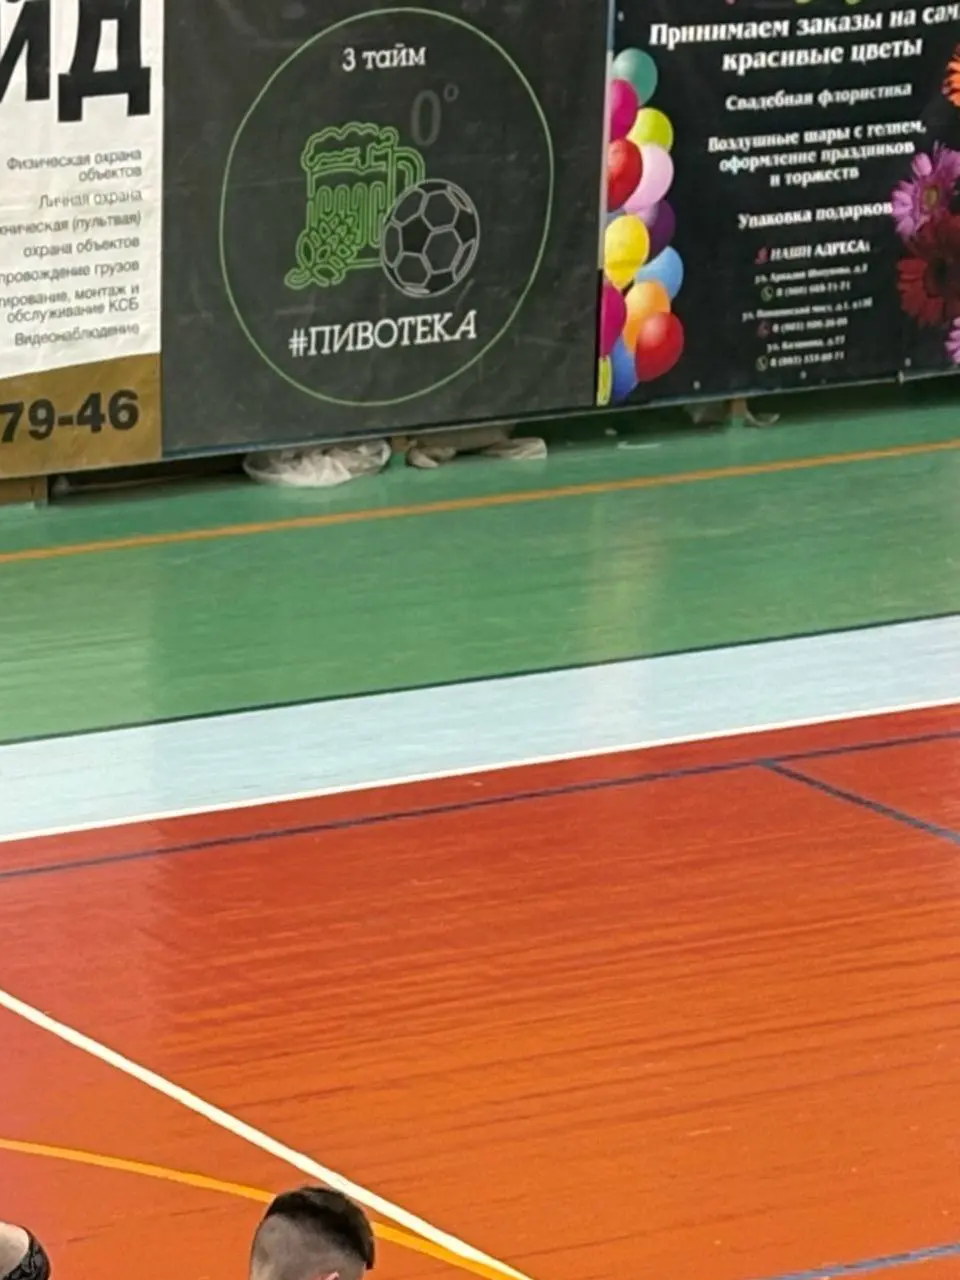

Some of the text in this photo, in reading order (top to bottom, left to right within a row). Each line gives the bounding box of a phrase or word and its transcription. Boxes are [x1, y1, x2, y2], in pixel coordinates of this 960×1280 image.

[649, 3, 960, 50] Принимаем заказы на сам
[342, 43, 427, 72] 3 тайм
[722, 38, 923, 76] красивые цветы
[725, 83, 912, 112] Свадебная флористика
[708, 132, 799, 152] Воздушные
[803, 127, 850, 145] шары
[853, 125, 863, 139] с
[7, 149, 142, 170] Физическая охрана
[719, 141, 915, 174] оформление праздников
[78, 165, 142, 182] объектов
[769, 166, 860, 188] и торжеств
[39, 190, 142, 209] Личная охрана
[738, 202, 893, 230] Упаковка подарков
[23, 236, 140, 259] охрана объектов
[770, 245, 812, 261] НАШИ
[94, 260, 140, 277] грузов
[74, 286, 126, 300] монтаж
[131, 284, 140, 294] и
[7, 297, 140, 323] обслуживание КСБ
[14, 324, 140, 347] Видеонаблюдение
[288, 310, 477, 358] #ПИВОТЕКА
